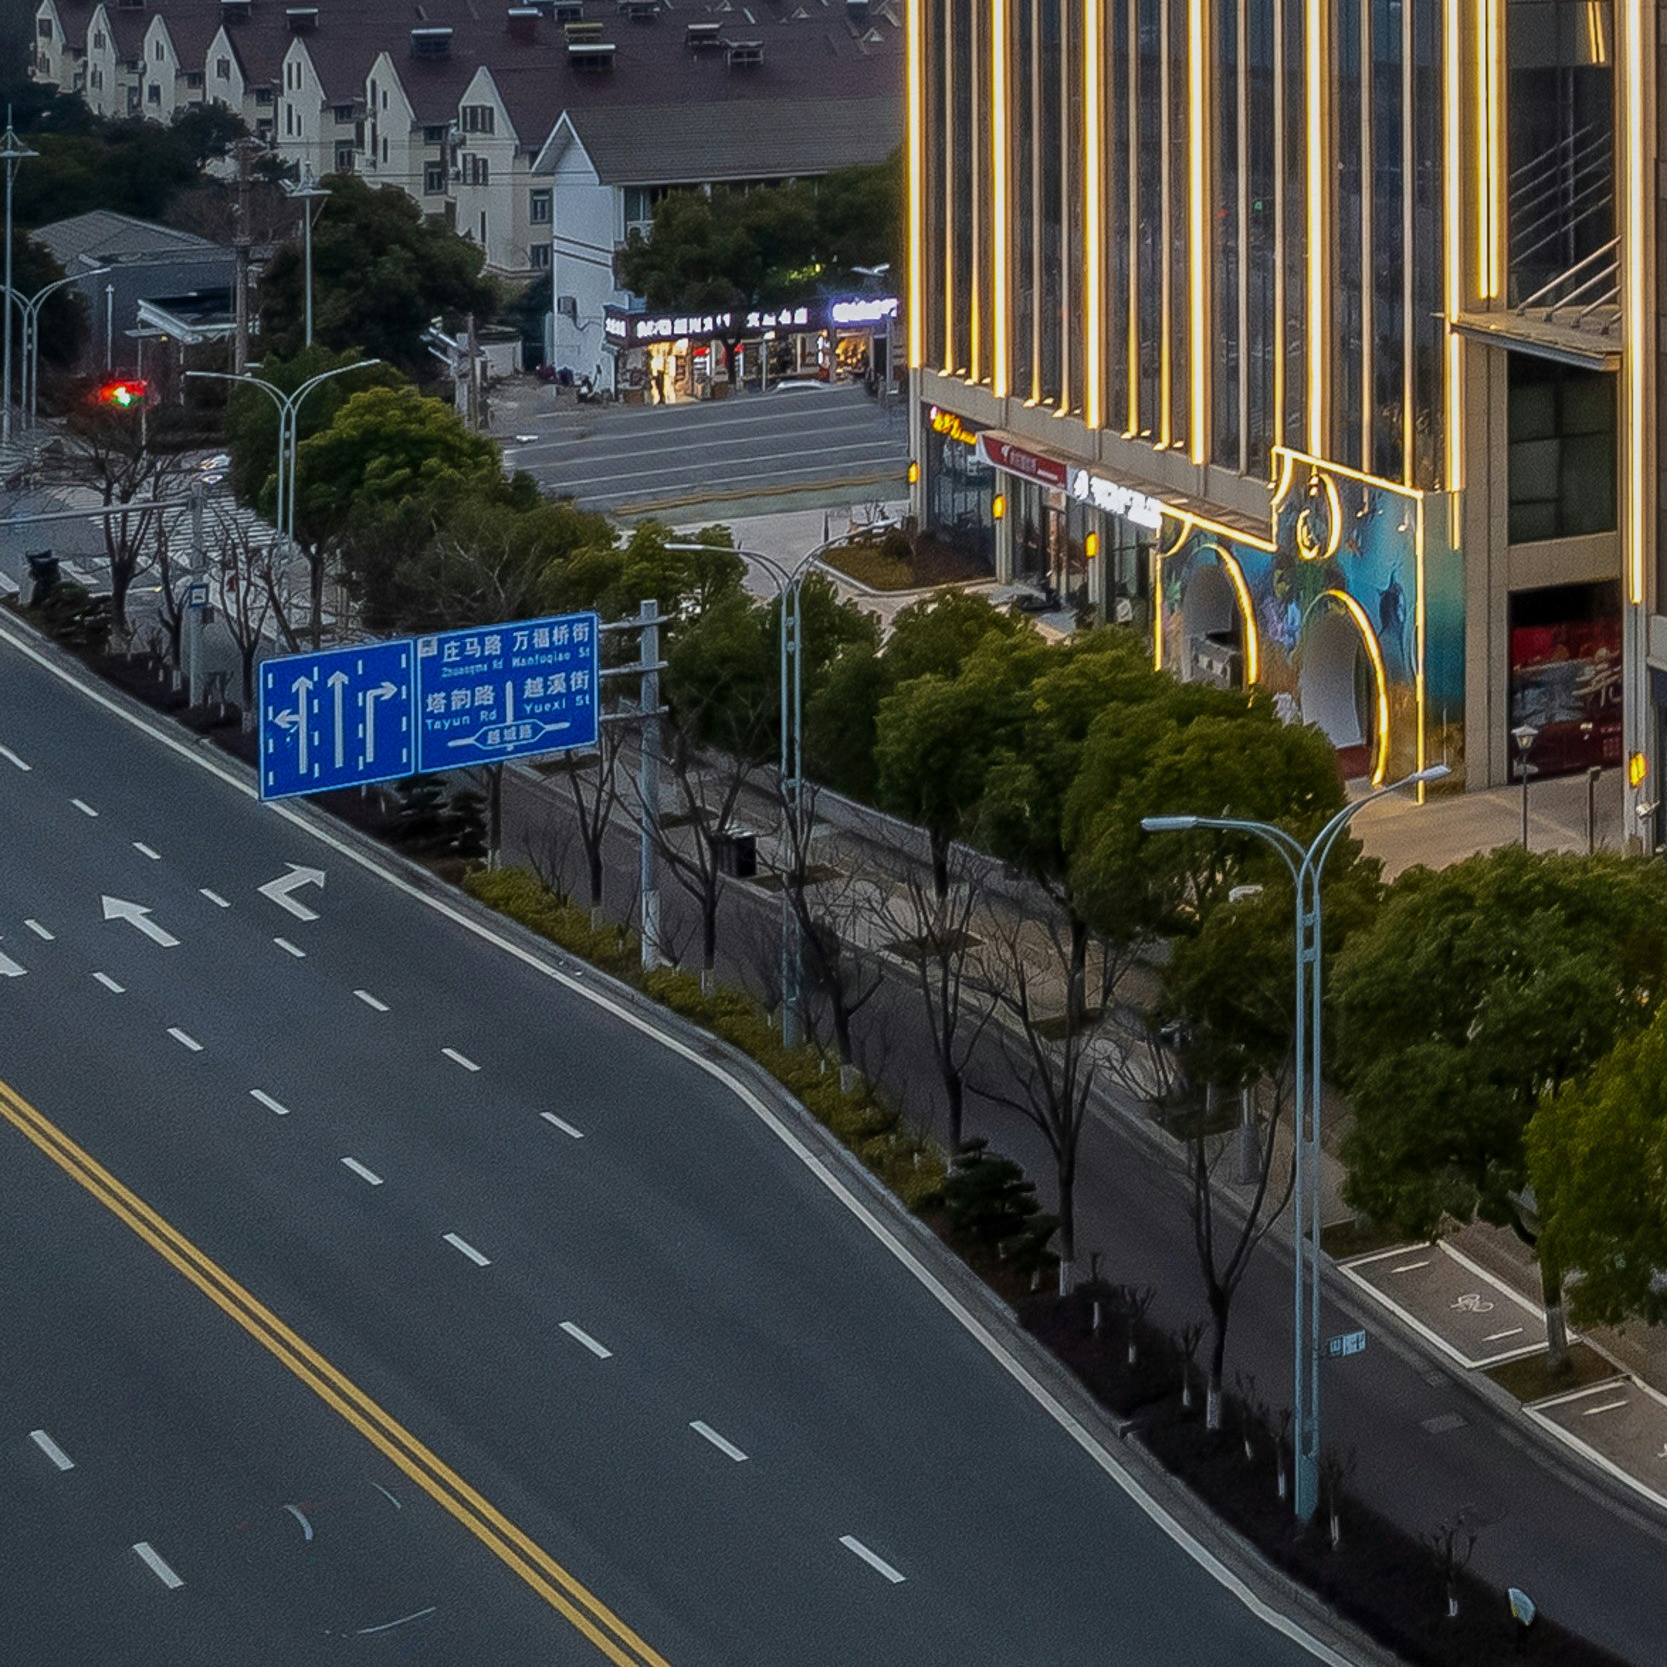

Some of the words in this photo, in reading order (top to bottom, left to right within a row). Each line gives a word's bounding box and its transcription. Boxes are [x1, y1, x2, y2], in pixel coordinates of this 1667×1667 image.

[441, 635, 502, 663] 庄马路
[513, 622, 590, 652] 万福桥街
[512, 651, 571, 668] Wanfuqiao
[523, 670, 590, 699] 越溪街
[426, 685, 496, 714] 塔韵路
[523, 698, 567, 715] Yuexi
[575, 694, 590, 706] St
[425, 714, 471, 731] Tayun
[480, 709, 498, 723] Rd
